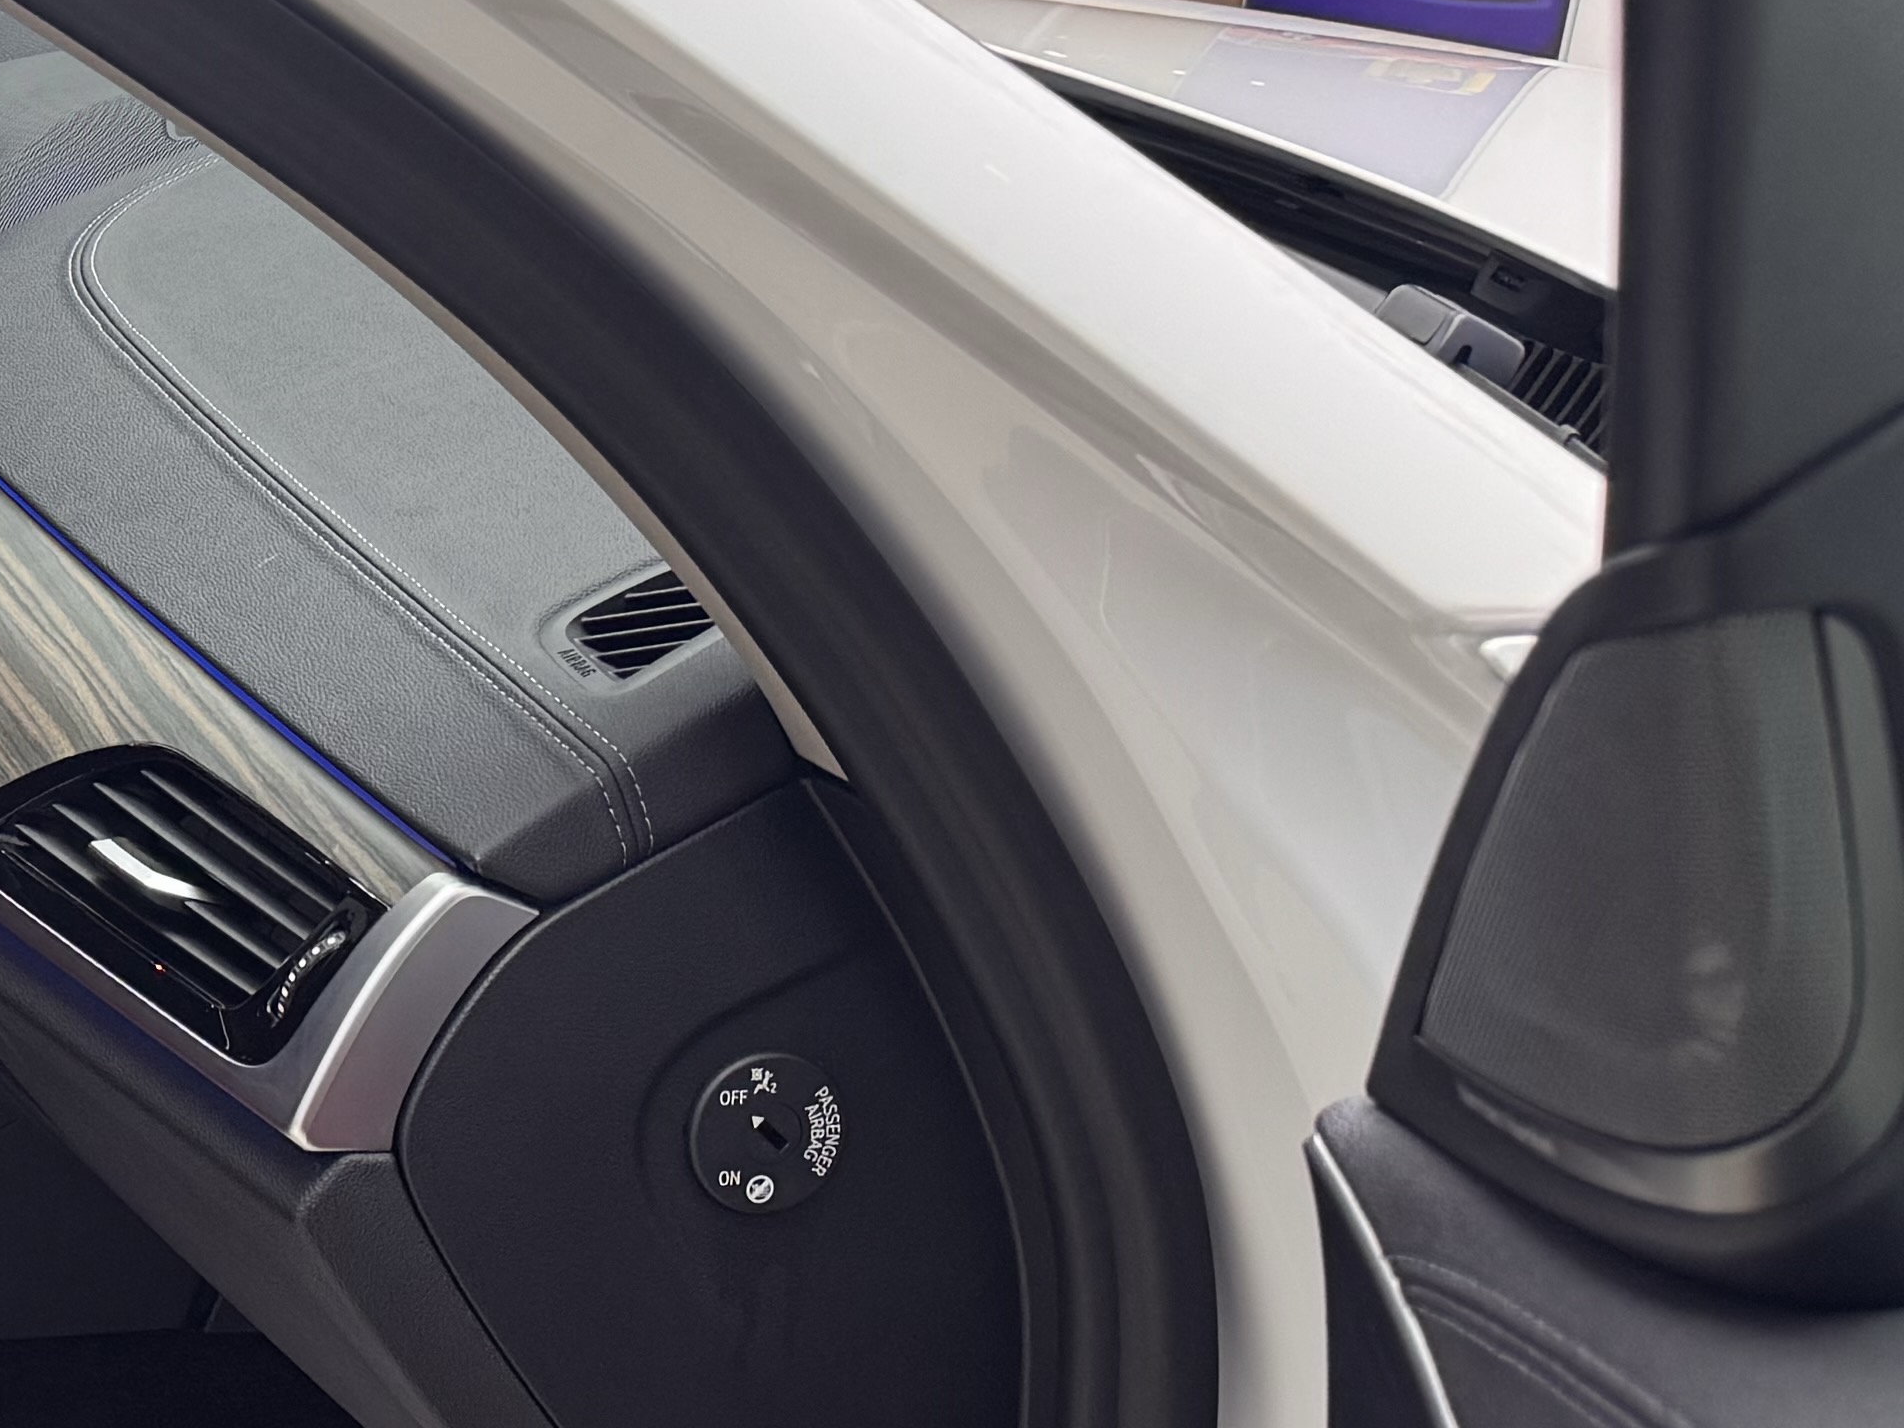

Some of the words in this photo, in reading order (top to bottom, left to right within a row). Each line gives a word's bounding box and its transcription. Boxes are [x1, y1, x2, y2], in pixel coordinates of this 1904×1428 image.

[557, 649, 597, 678] AIRBAG
[719, 1089, 748, 1106] OFF
[803, 1103, 825, 1163] AIRBAG
[811, 1085, 841, 1177] PASSENGER
[718, 1170, 741, 1186] ON
